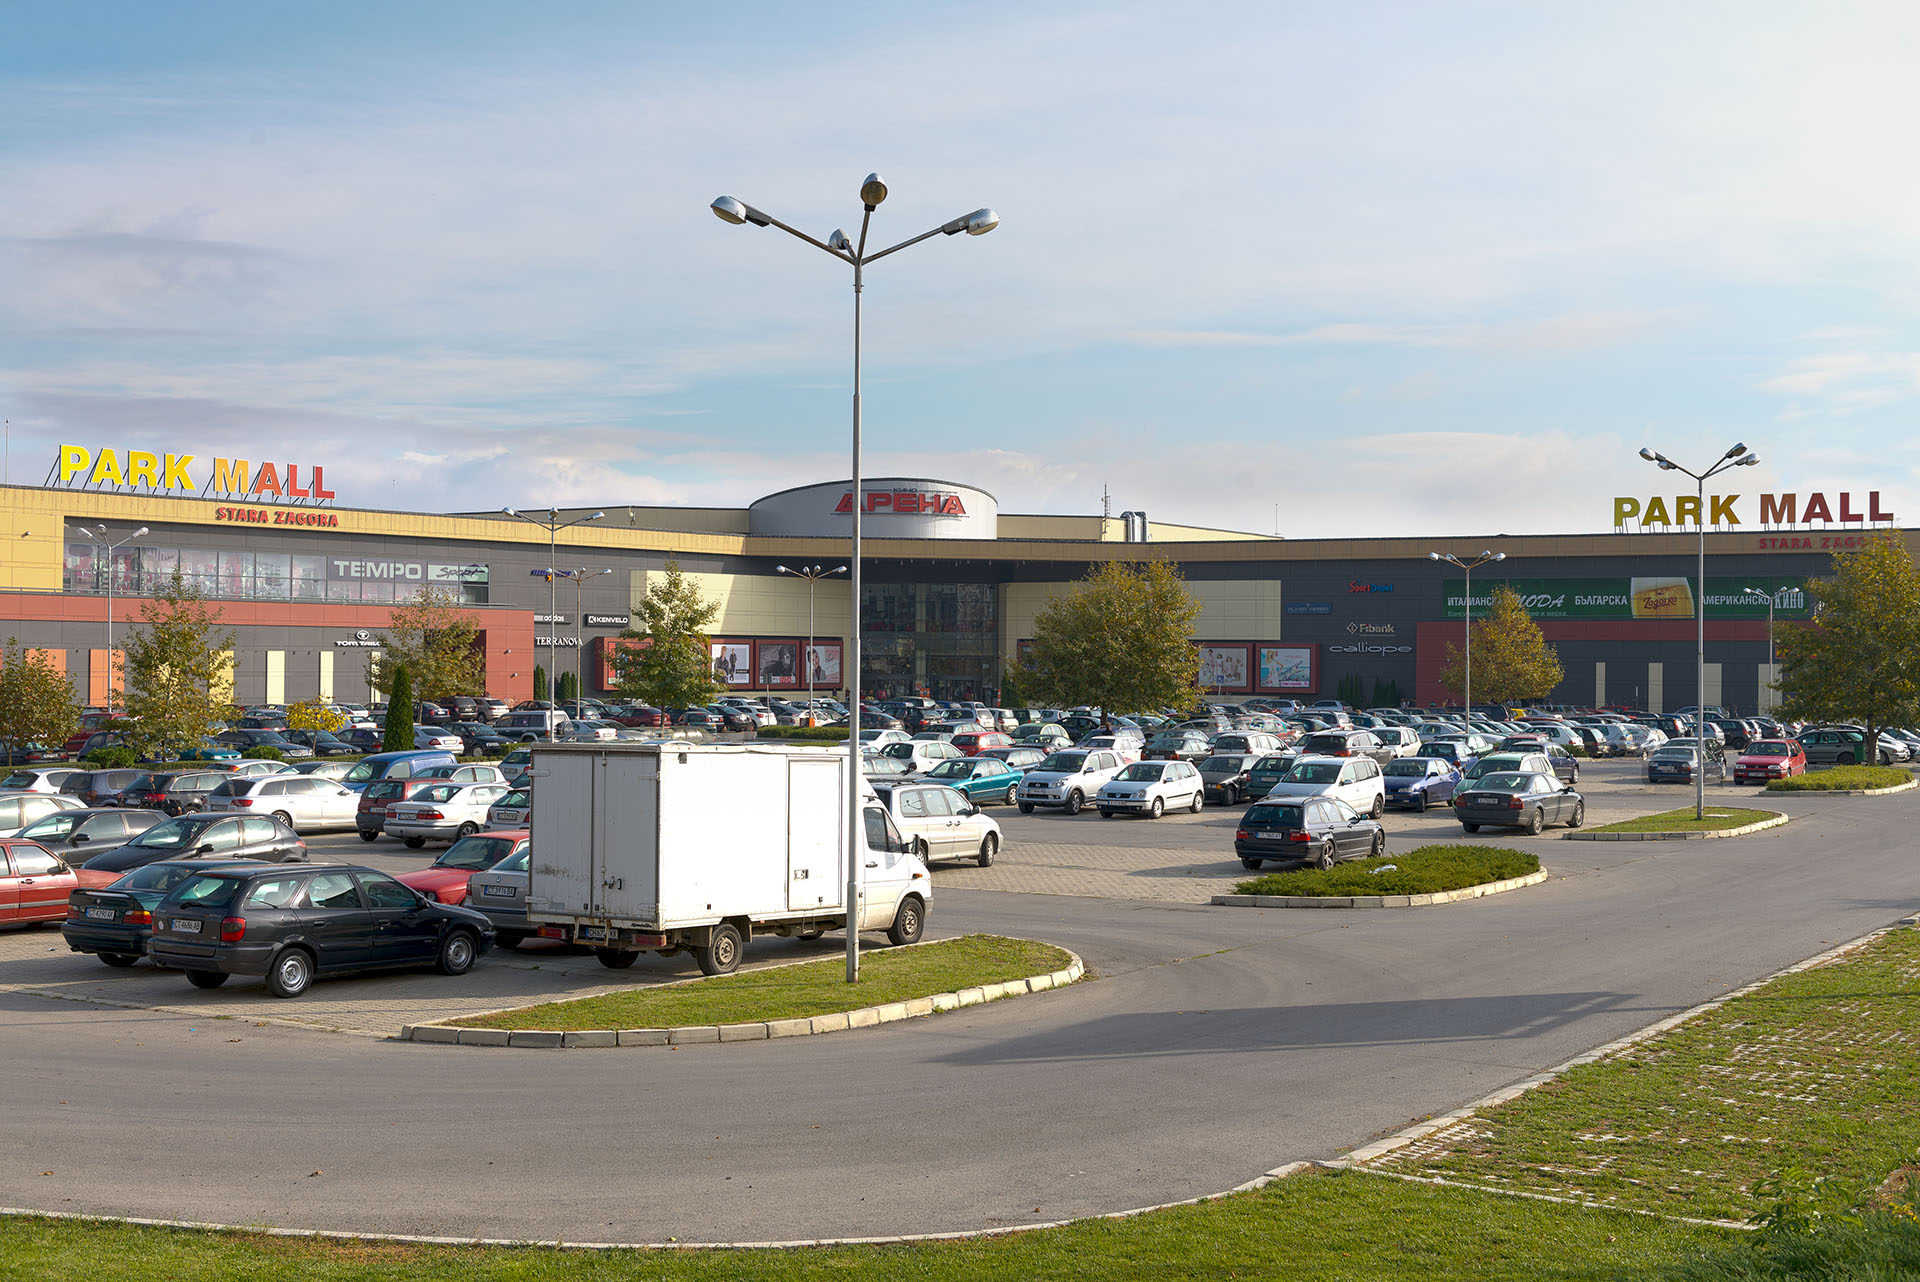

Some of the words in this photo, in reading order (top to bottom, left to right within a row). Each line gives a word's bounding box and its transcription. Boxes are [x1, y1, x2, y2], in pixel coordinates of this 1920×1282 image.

[60, 444, 197, 490] PARK
[213, 457, 335, 499] MALL
[834, 493, 966, 514] АРЕНА
[1614, 495, 1741, 526] PARK
[1760, 491, 1894, 523] MALL
[216, 507, 269, 523] STARA
[274, 511, 339, 527] ZAGORA
[1759, 537, 1813, 549] STARA
[1822, 536, 1892, 549] ZAGO
[334, 560, 422, 579] TEMPO
[1575, 595, 1628, 605] БЪЛГАРСКА
[1643, 596, 1678, 609] Zagorka
[1774, 592, 1804, 608] КИНО
[543, 614, 565, 622] addas
[596, 616, 628, 624] KENVELO
[1360, 623, 1395, 633] Fibank
[536, 637, 583, 646] TERRANOVA
[1329, 642, 1412, 657] calliope
